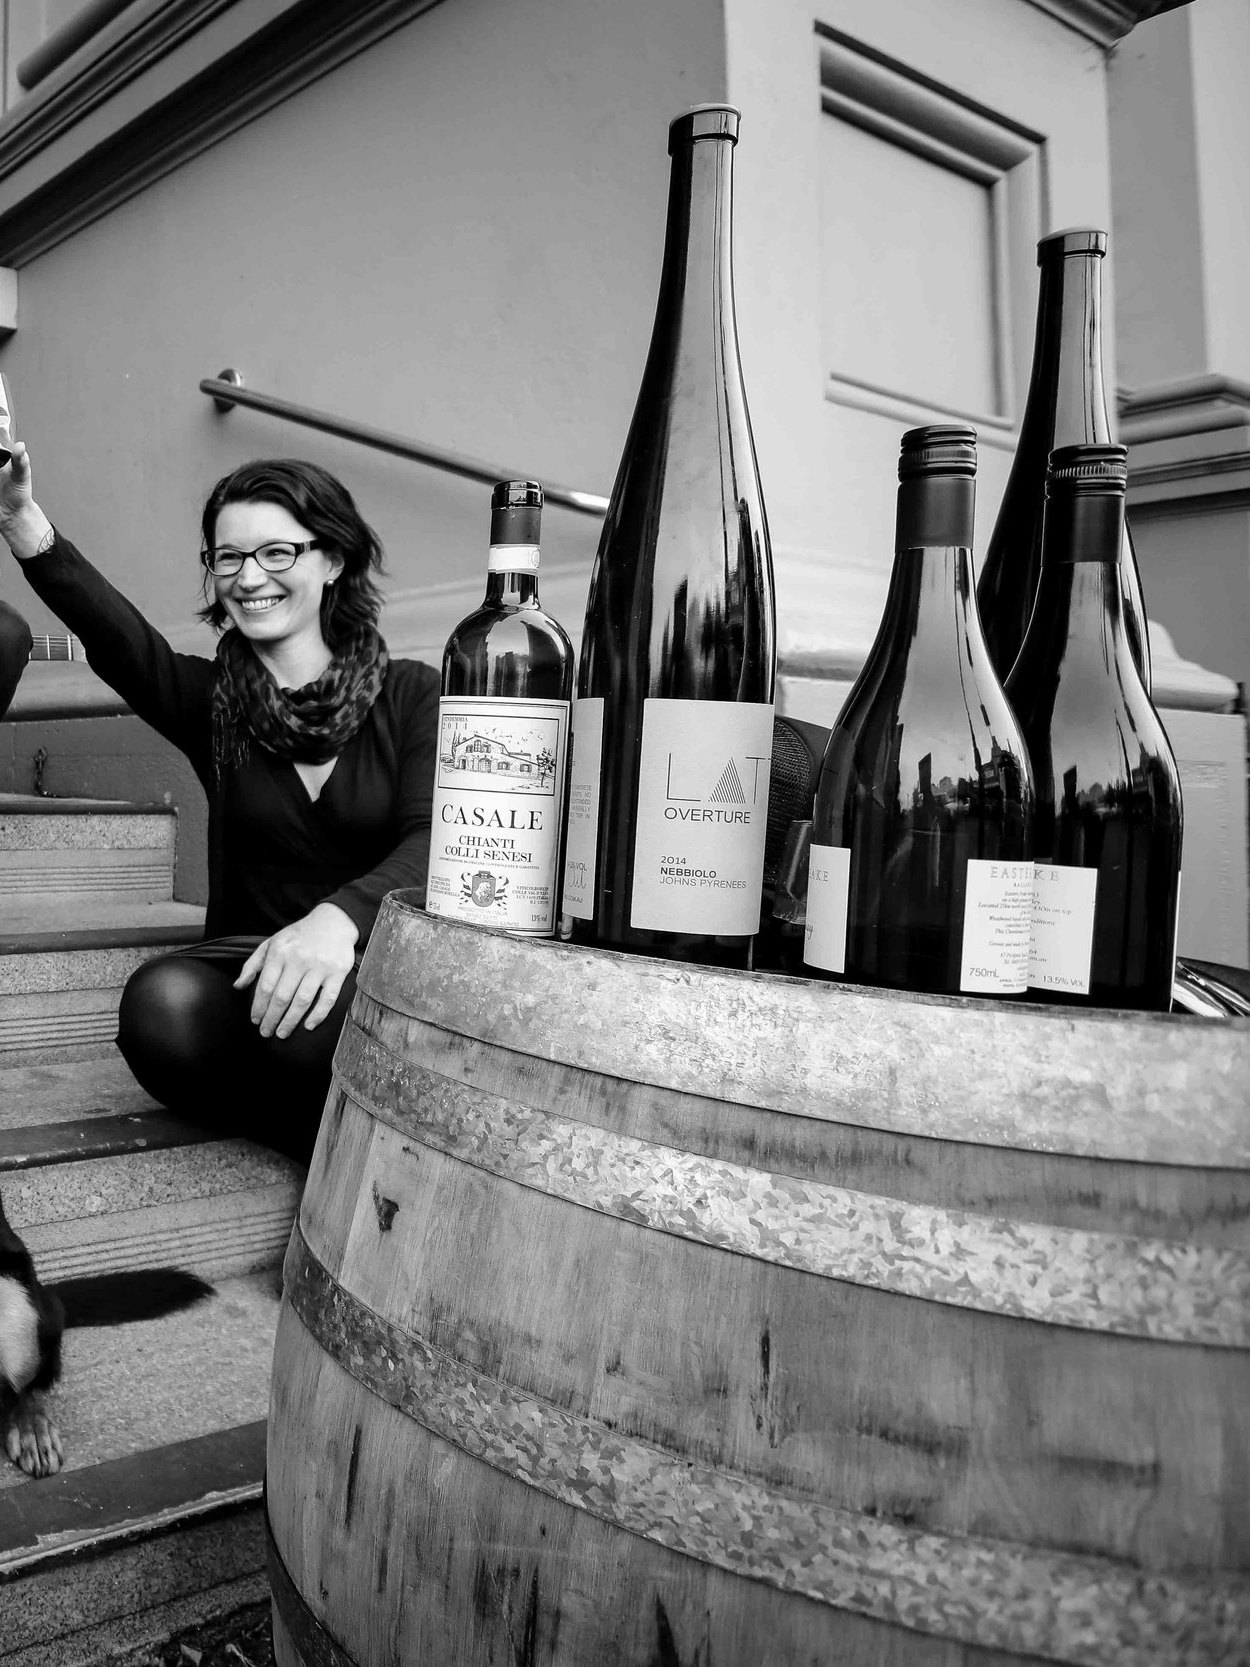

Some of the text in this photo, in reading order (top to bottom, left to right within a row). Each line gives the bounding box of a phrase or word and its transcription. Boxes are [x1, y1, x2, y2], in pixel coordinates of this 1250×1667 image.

[667, 753, 771, 804] LAT
[441, 804, 543, 830] CASALE
[664, 807, 751, 824] OVERTURE
[459, 835, 515, 849] CHIANTI
[445, 845, 533, 863] COLLI SENESI
[661, 856, 687, 865] 2014
[660, 867, 717, 878] NEBBIOLO
[660, 876, 747, 889] JOHNS PYRENEES
[969, 967, 999, 978] 750mL
[1043, 975, 1069, 985] 13.5%
